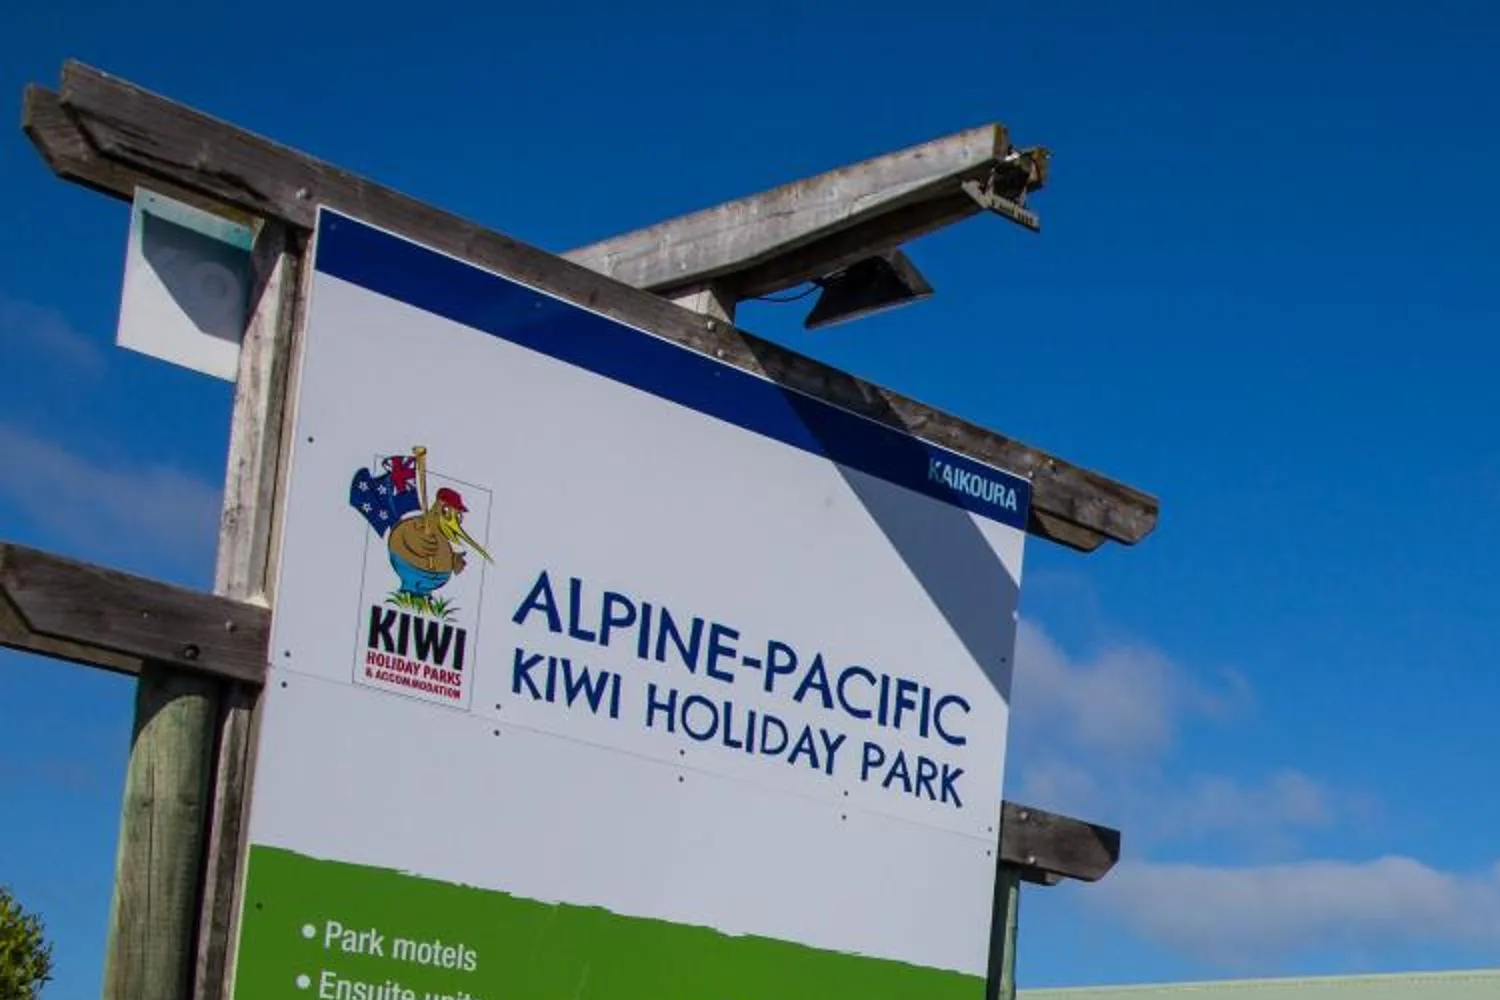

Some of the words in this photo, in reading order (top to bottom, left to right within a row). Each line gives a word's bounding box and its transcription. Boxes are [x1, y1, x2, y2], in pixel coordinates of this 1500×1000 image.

[927, 457, 1017, 512] KAIKOURA
[368, 604, 467, 671] KIWI
[512, 570, 972, 746] ALPINE-PACIFIC
[366, 651, 423, 677] HOLIDAY
[424, 663, 462, 687] PARKS
[375, 668, 461, 699] ACCOMMODATION
[512, 648, 622, 719] KIWI
[646, 684, 846, 775] HOLIDAY
[861, 742, 964, 808] PARK
[324, 920, 384, 958] Park
[392, 937, 478, 973] motels
